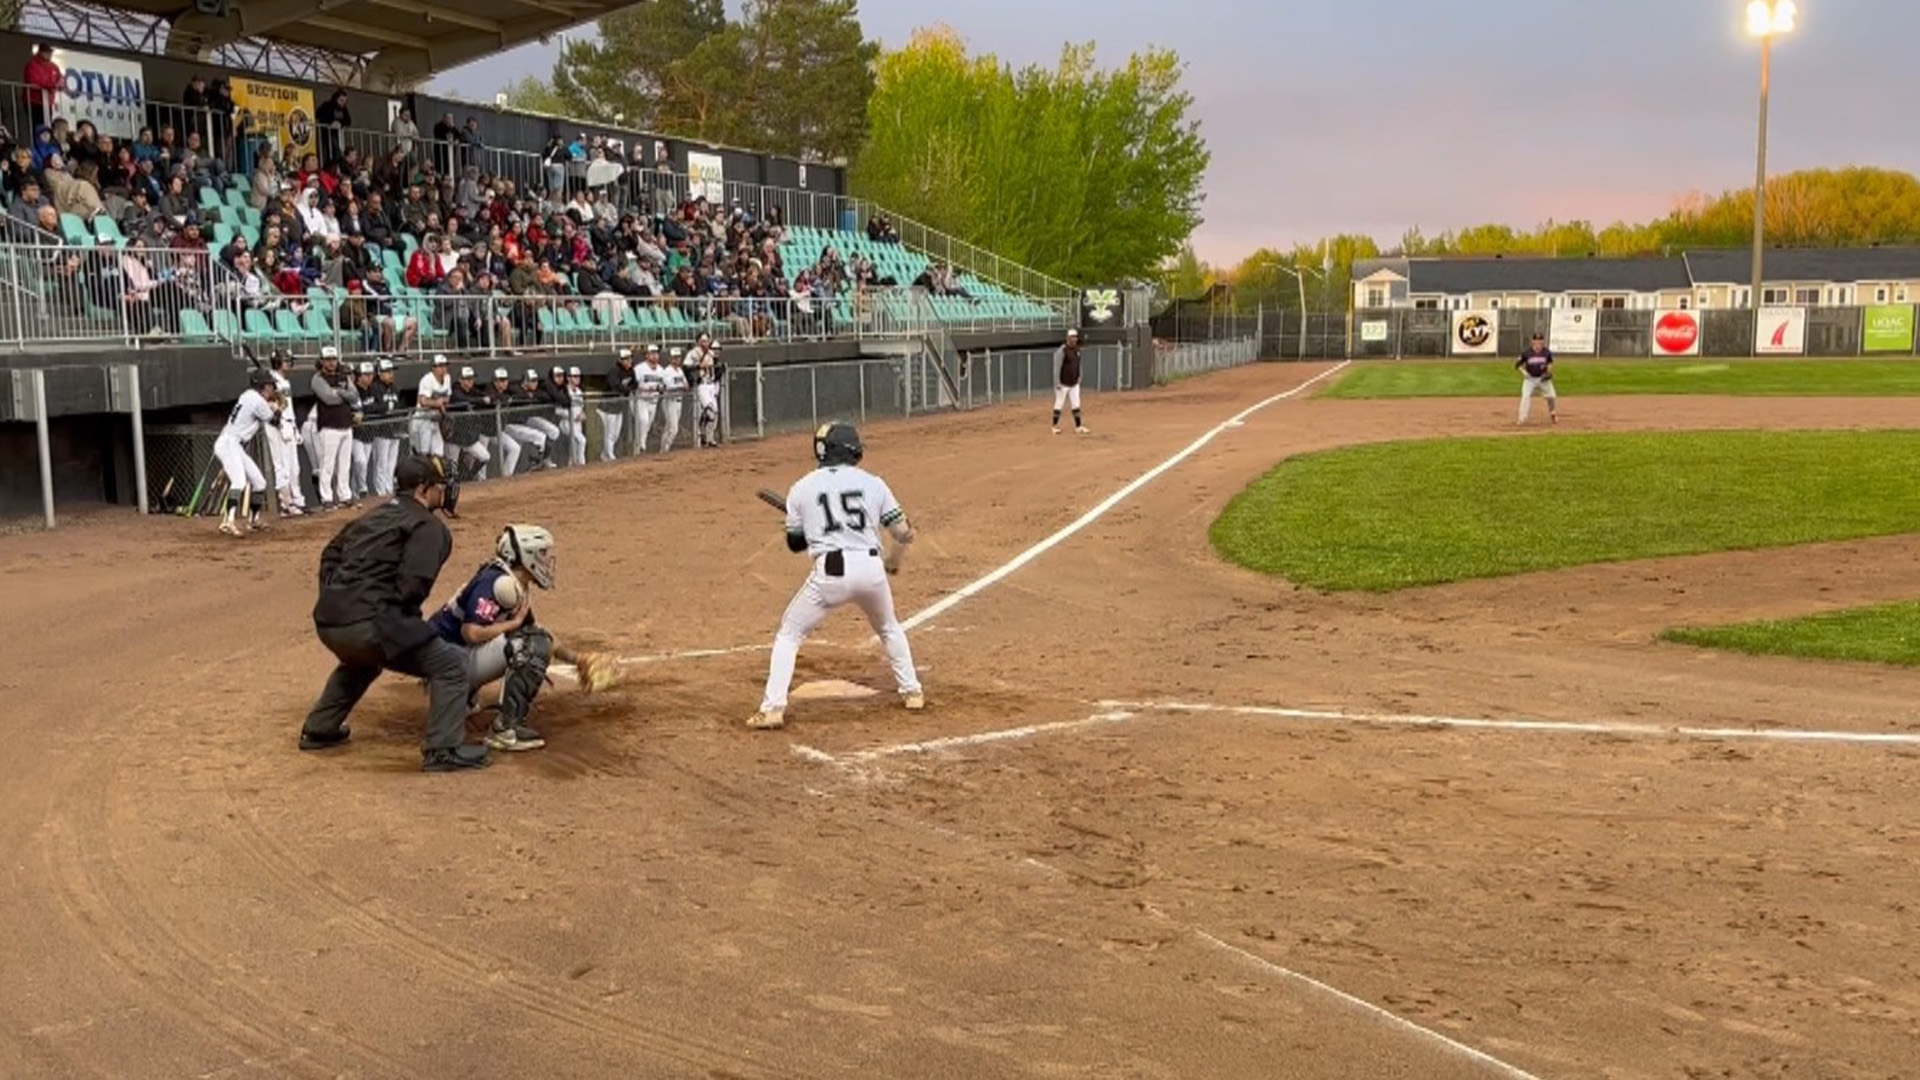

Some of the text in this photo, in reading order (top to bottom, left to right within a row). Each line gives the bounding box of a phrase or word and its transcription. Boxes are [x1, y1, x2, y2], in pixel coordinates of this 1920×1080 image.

[64, 67, 141, 108] OTVIN
[247, 83, 299, 102] SECTION
[817, 490, 866, 535] 15
